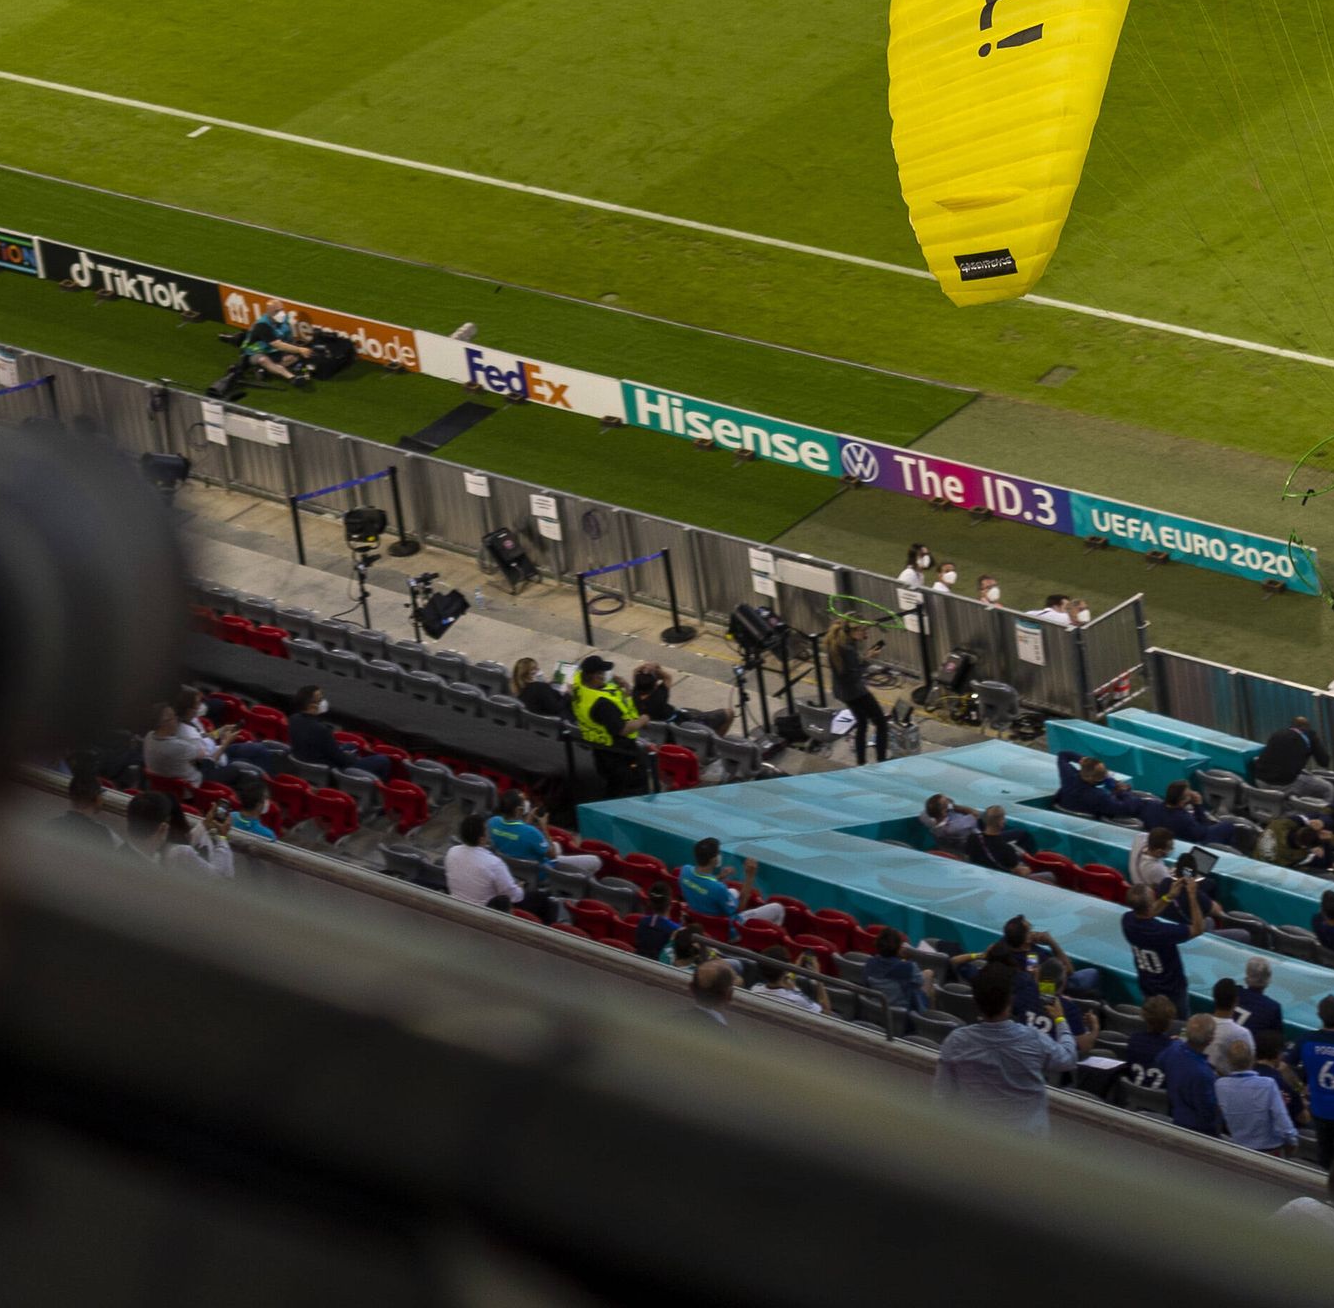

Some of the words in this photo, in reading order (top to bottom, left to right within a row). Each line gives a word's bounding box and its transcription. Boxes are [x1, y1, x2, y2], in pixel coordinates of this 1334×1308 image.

[96, 264, 192, 313] TikTok
[464, 346, 573, 410] FedEx
[634, 387, 831, 472] Hisense
[893, 453, 967, 506] The
[982, 474, 1059, 527] ID.3
[1091, 507, 1159, 547] UEFA
[1161, 526, 1227, 565] EURO
[1228, 543, 1294, 579] 2020
[1133, 946, 1164, 975] 10
